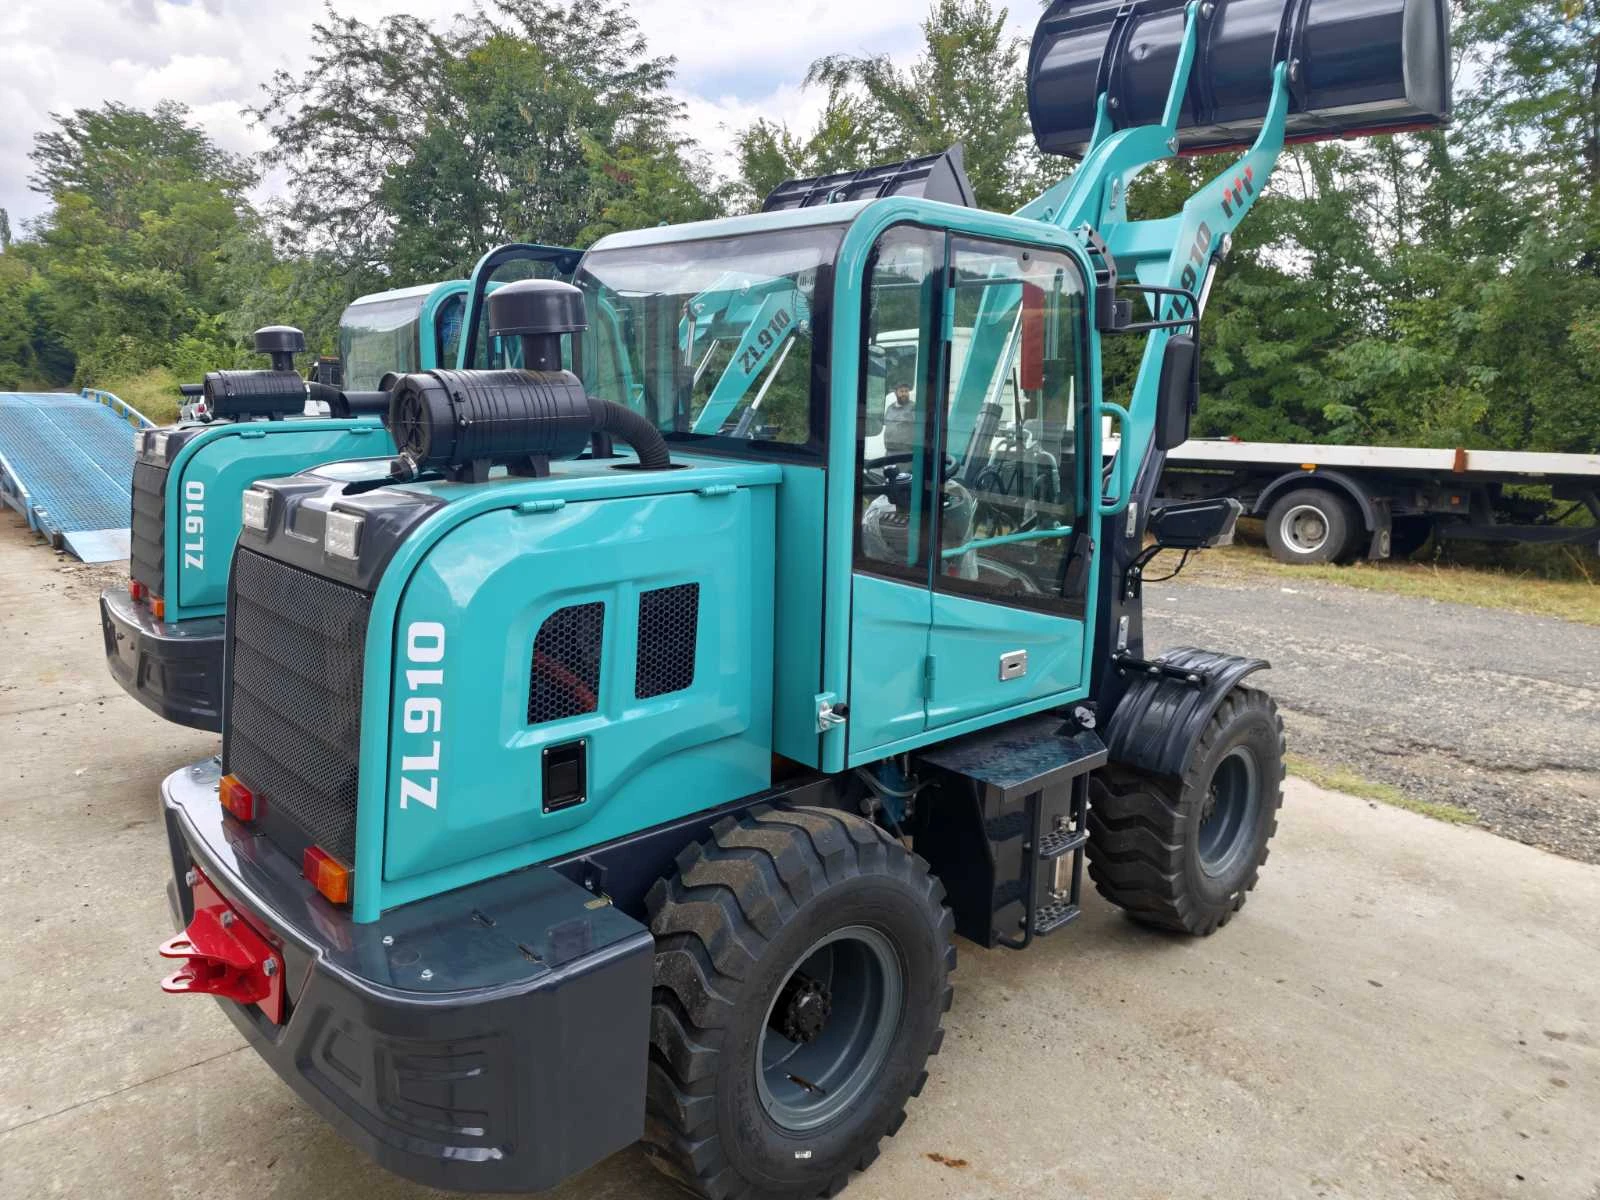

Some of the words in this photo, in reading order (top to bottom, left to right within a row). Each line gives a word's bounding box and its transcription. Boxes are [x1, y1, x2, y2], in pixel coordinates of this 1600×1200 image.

[738, 308, 791, 375] ZL910
[184, 481, 205, 570] ZL910
[400, 621, 446, 810] ZL910
